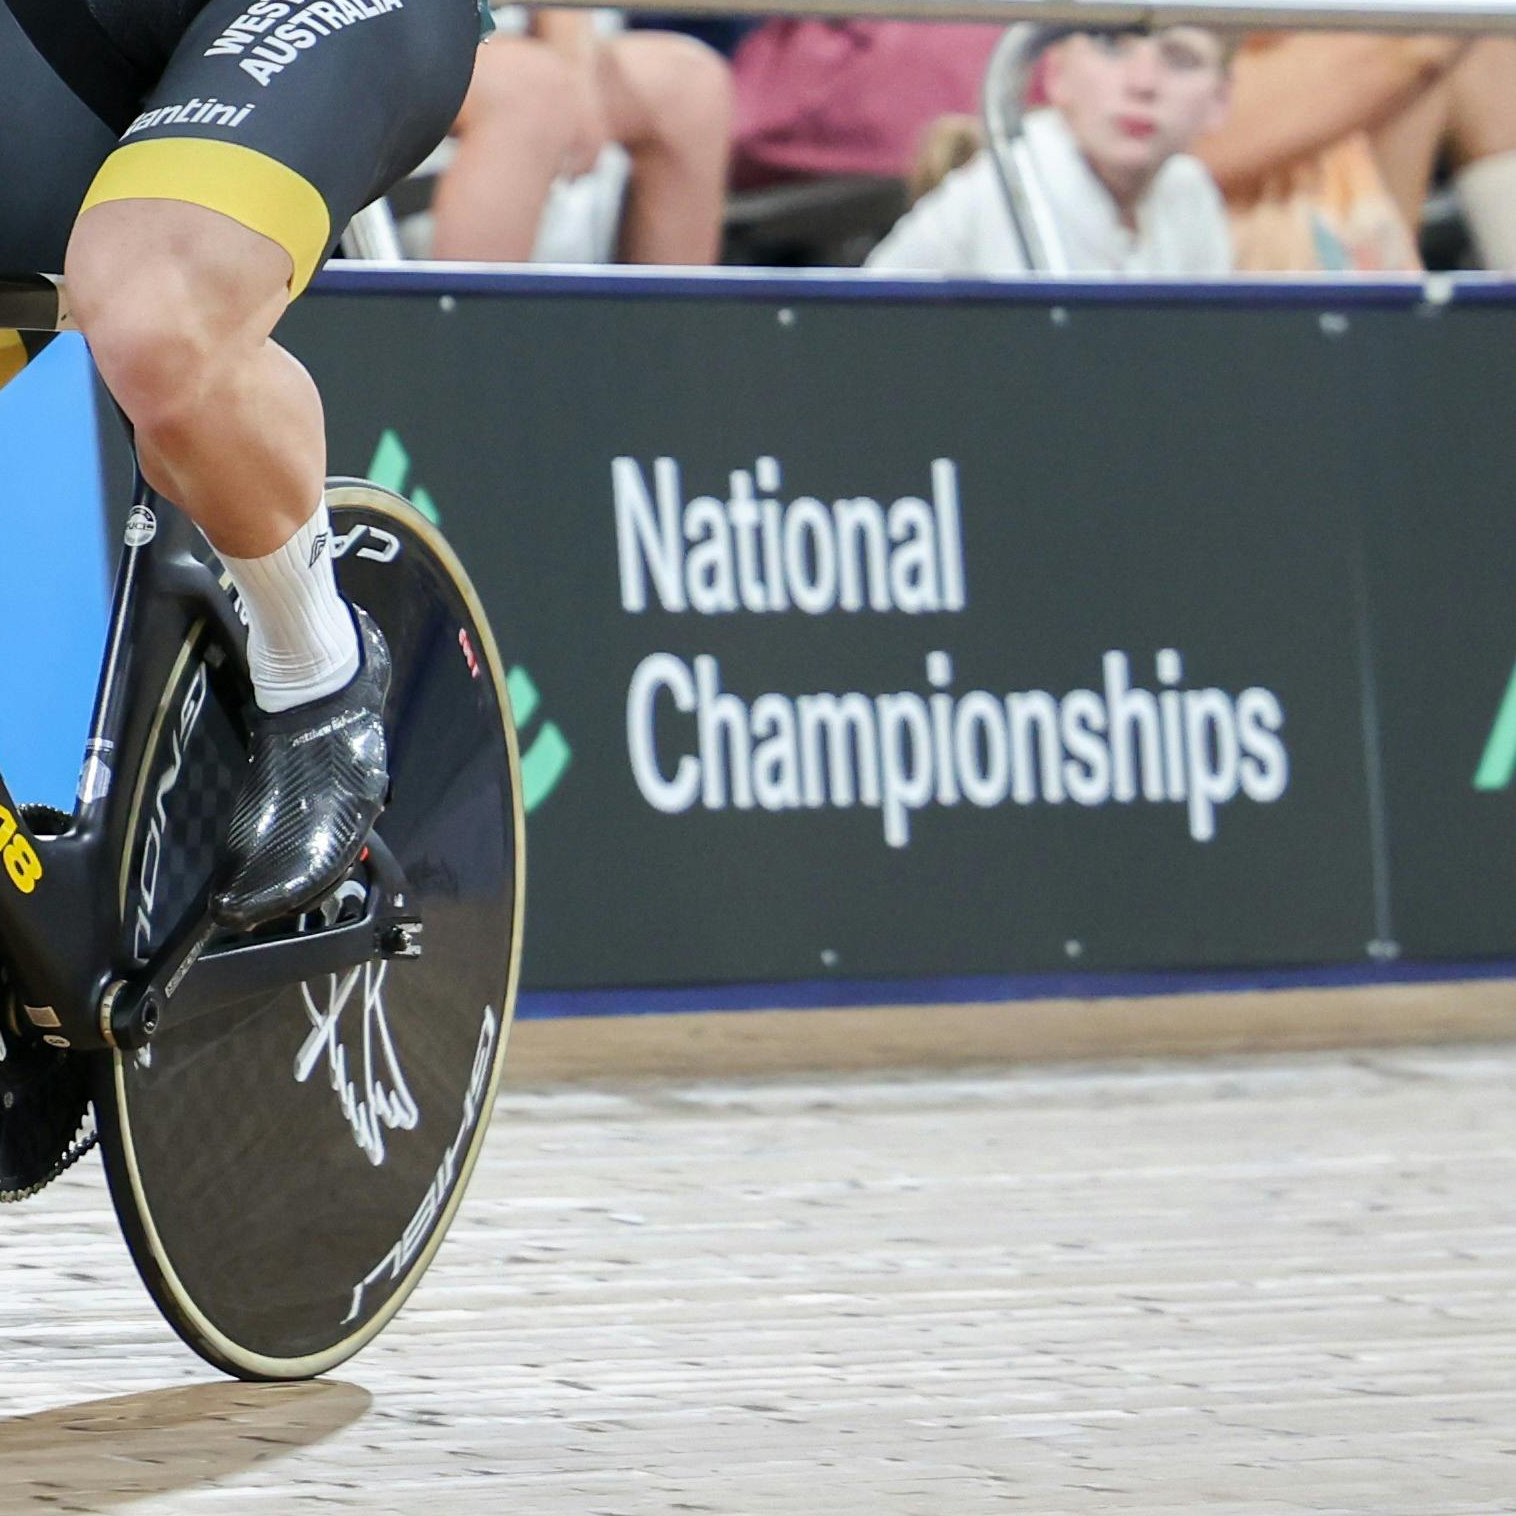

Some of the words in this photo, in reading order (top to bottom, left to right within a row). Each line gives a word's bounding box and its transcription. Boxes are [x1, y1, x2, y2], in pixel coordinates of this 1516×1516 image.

[612, 456, 965, 614] National
[627, 650, 1287, 848] Championships
[340, 1005, 496, 1325] GHIBLI
